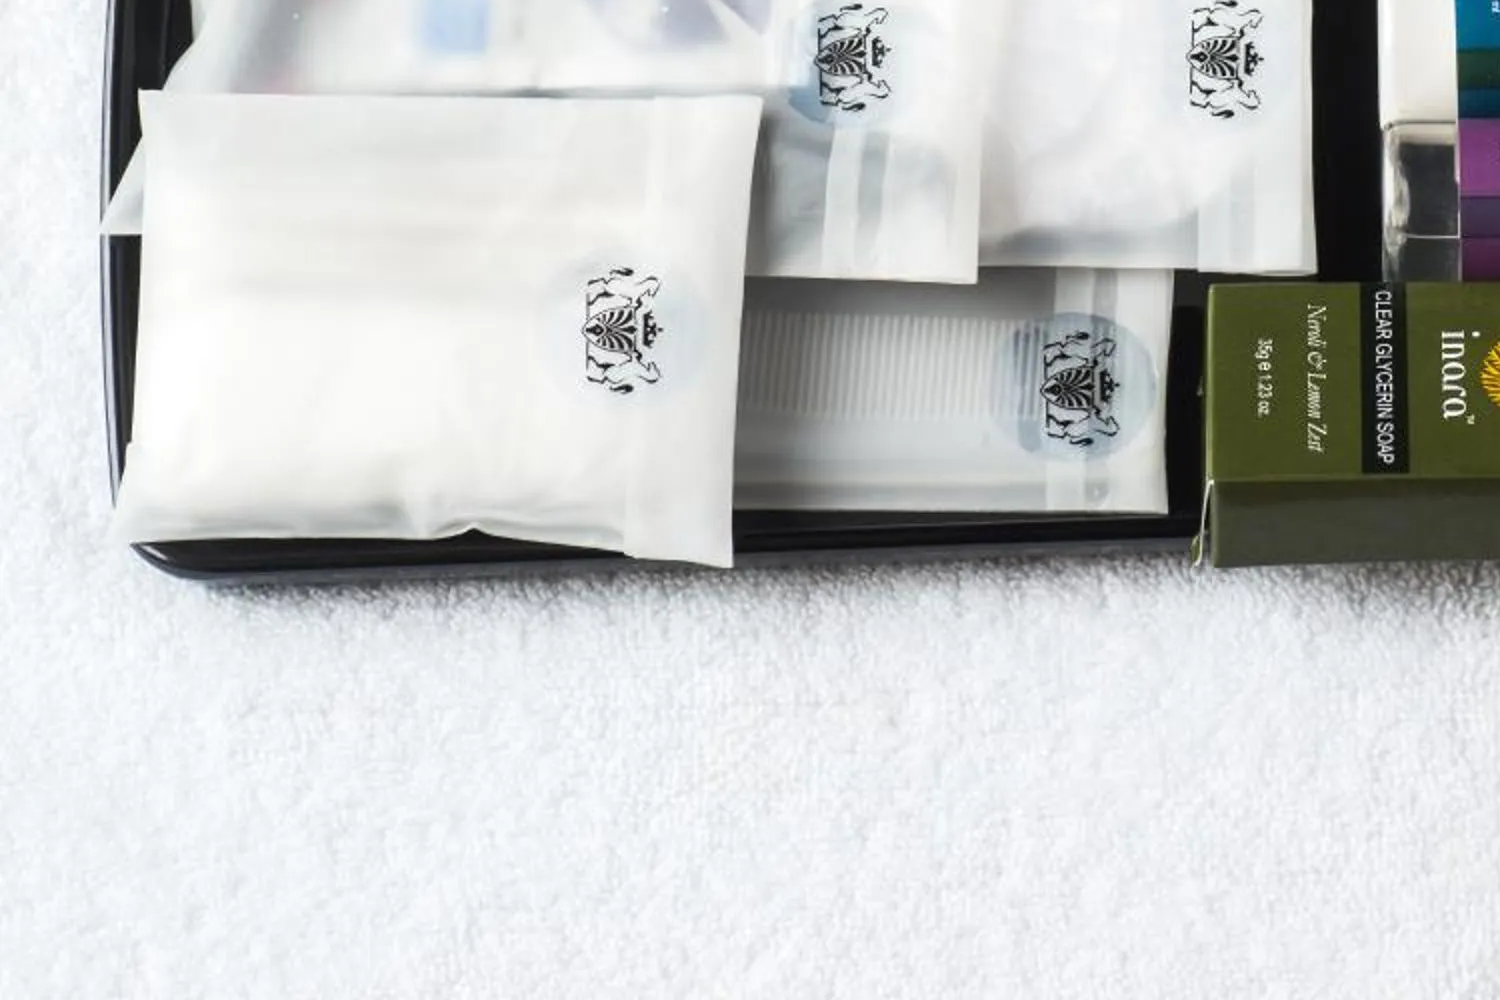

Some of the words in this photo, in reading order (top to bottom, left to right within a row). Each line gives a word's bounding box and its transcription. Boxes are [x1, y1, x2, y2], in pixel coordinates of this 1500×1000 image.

[1307, 303, 1327, 348] Neroli
[1375, 291, 1393, 340] CLEAR
[1307, 351, 1325, 370] &
[1375, 344, 1393, 419] GLYCERIN
[1441, 330, 1481, 421] inara
[1307, 372, 1327, 419] Lemon
[1307, 423, 1328, 453] Zest
[1376, 422, 1395, 465] SOAP
